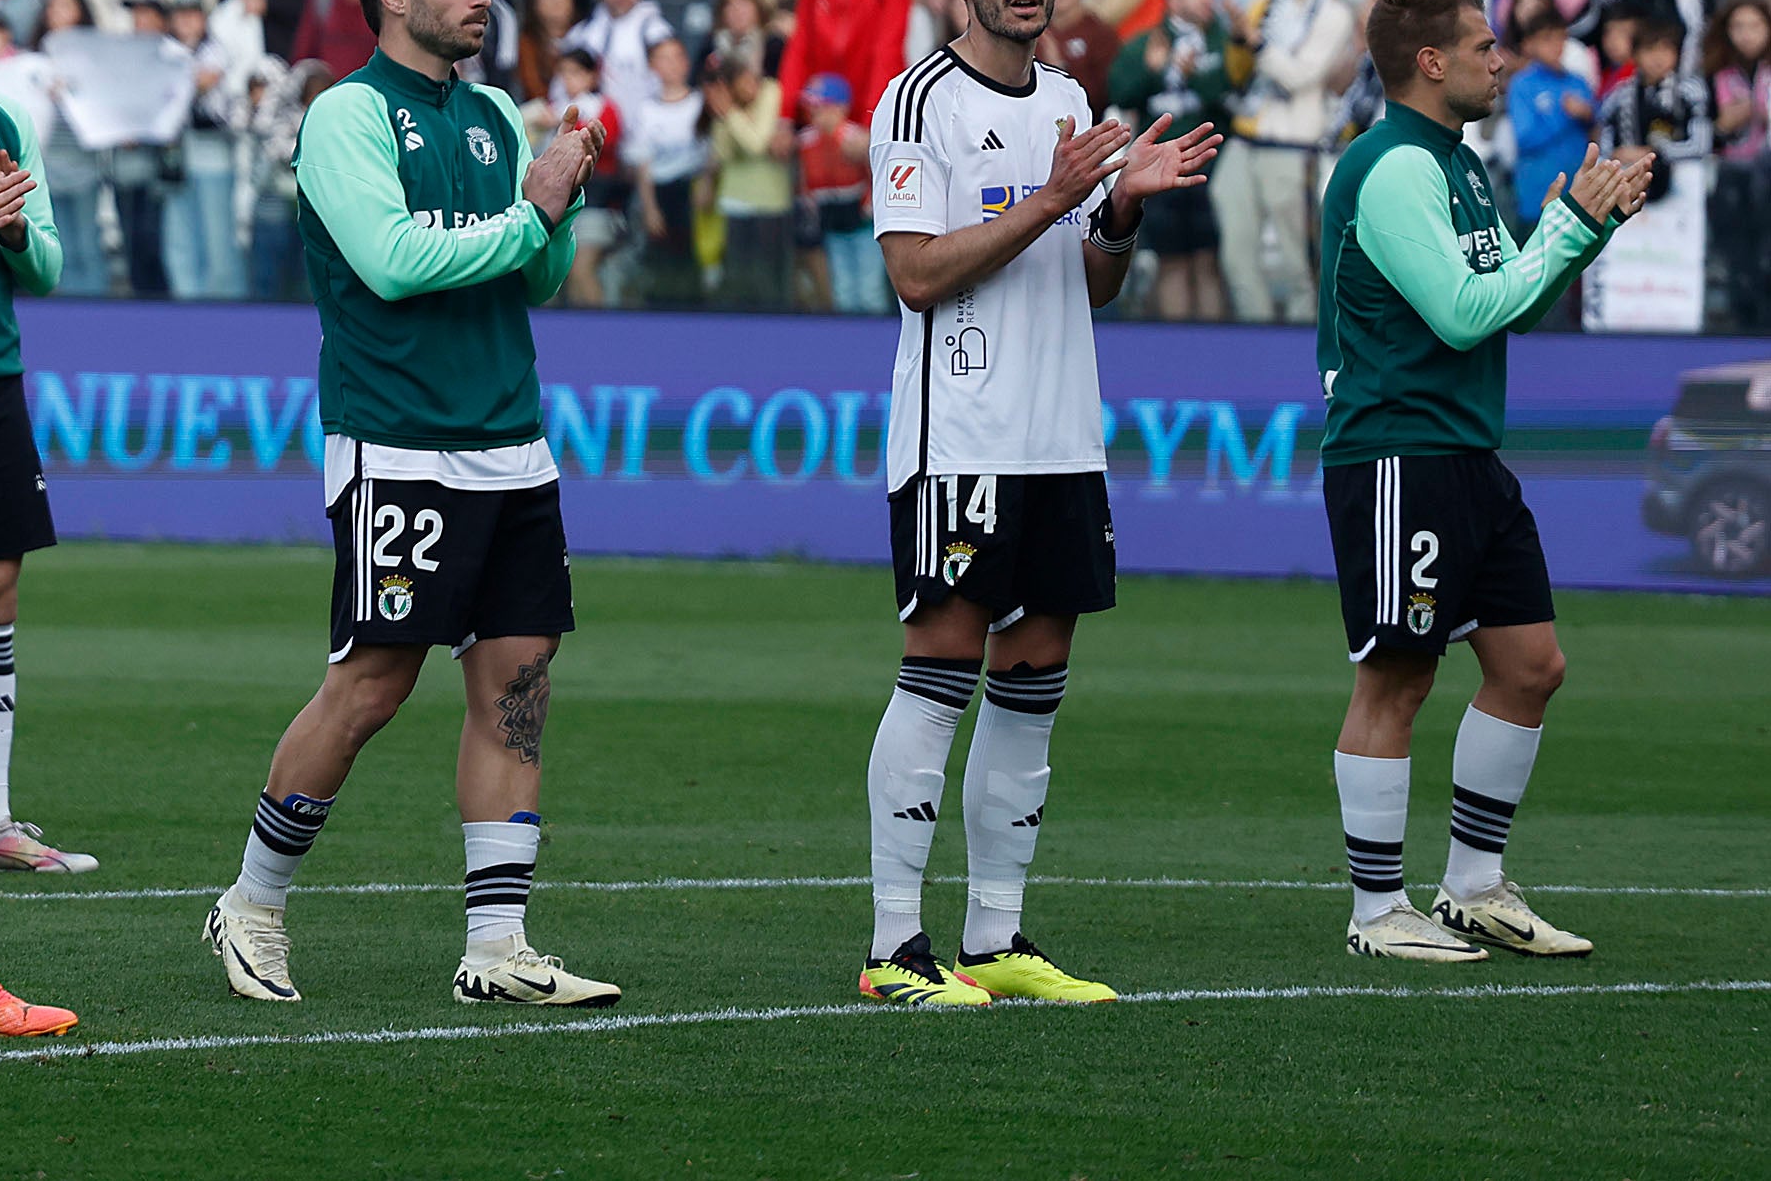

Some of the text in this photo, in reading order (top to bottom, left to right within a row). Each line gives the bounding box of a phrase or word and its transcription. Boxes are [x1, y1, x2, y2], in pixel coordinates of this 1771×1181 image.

[888, 192, 917, 201] LALIGA
[956, 291, 965, 323] Burgo
[939, 474, 997, 534] 14
[373, 504, 444, 572] 22
[1410, 530, 1439, 588] 2
